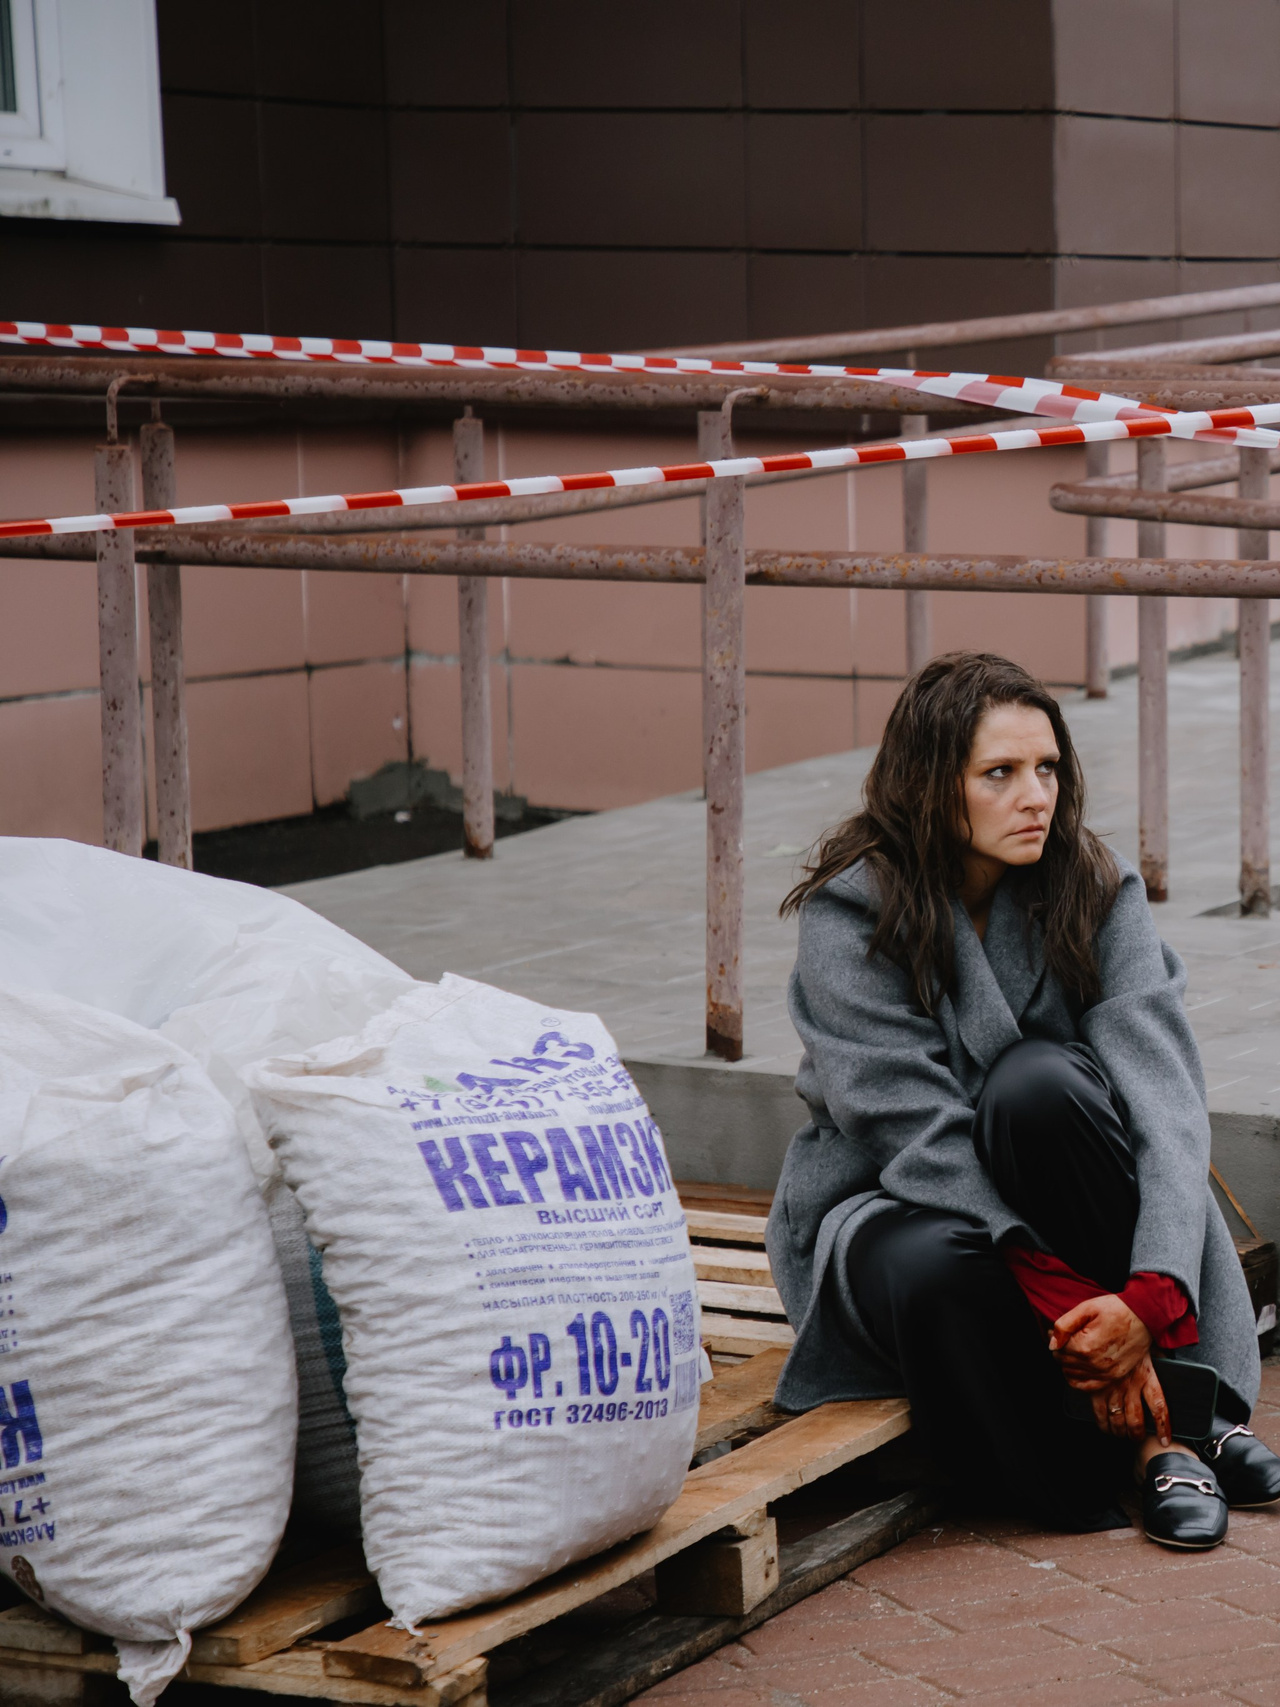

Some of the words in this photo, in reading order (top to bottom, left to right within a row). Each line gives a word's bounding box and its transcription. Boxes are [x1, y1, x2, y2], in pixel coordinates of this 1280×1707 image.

[536, 1202, 630, 1225] ВЫСШИЙ
[633, 1201, 665, 1218] СОРТ
[482, 1295, 554, 1312] НАСЫПНАЯ
[558, 1292, 617, 1305] ПЛОТНОСТЬ
[489, 1333, 563, 1400] ФР.
[566, 1307, 671, 1397] 10-20
[494, 1407, 556, 1430] ГОСТ
[566, 1398, 668, 1425] 32496-2013
